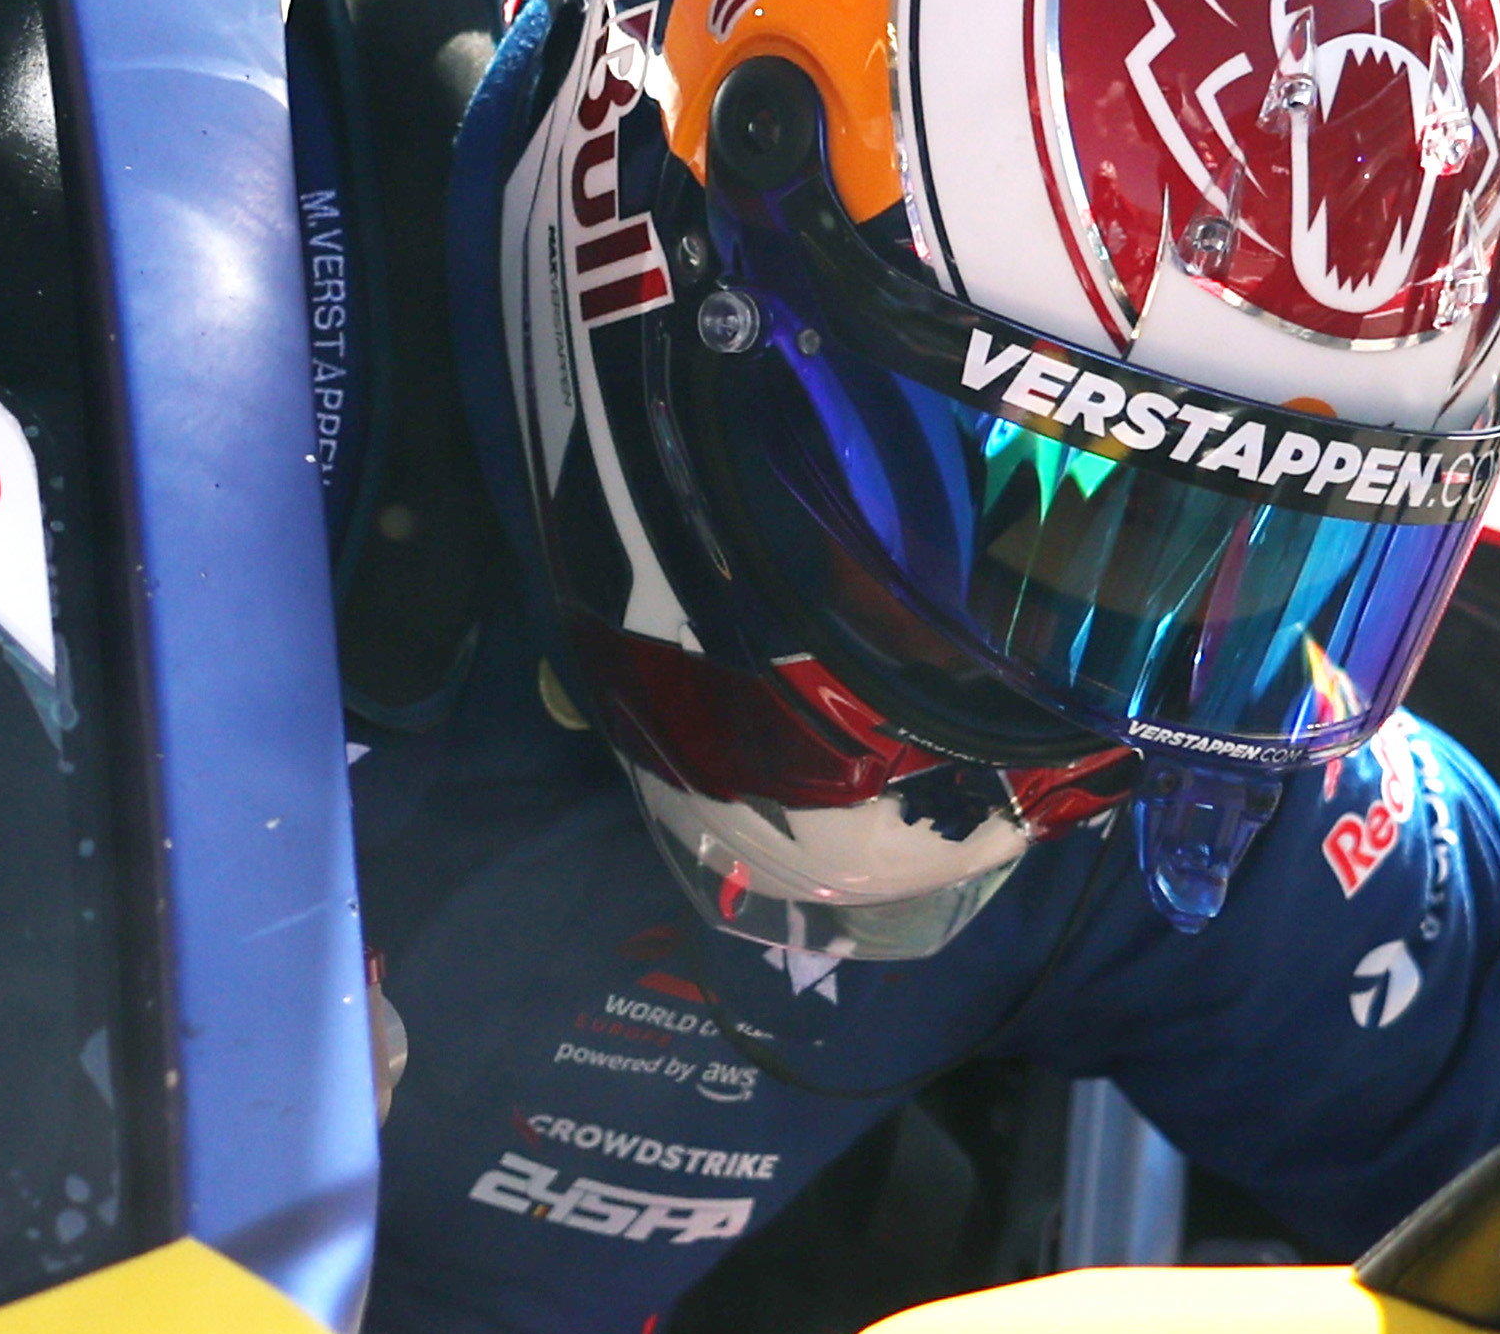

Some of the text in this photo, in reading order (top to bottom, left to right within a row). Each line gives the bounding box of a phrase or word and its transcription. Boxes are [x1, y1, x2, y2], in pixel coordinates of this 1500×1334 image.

[572, 12, 670, 323] Bull
[959, 328, 1500, 508] VERSTAPPEN.CO
[1127, 720, 1303, 764] VERSTAPPEN.COM
[605, 993, 697, 1035] WORLD
[554, 1041, 758, 1088] powered by aws
[526, 1113, 781, 1181] CROWDSTRIKE
